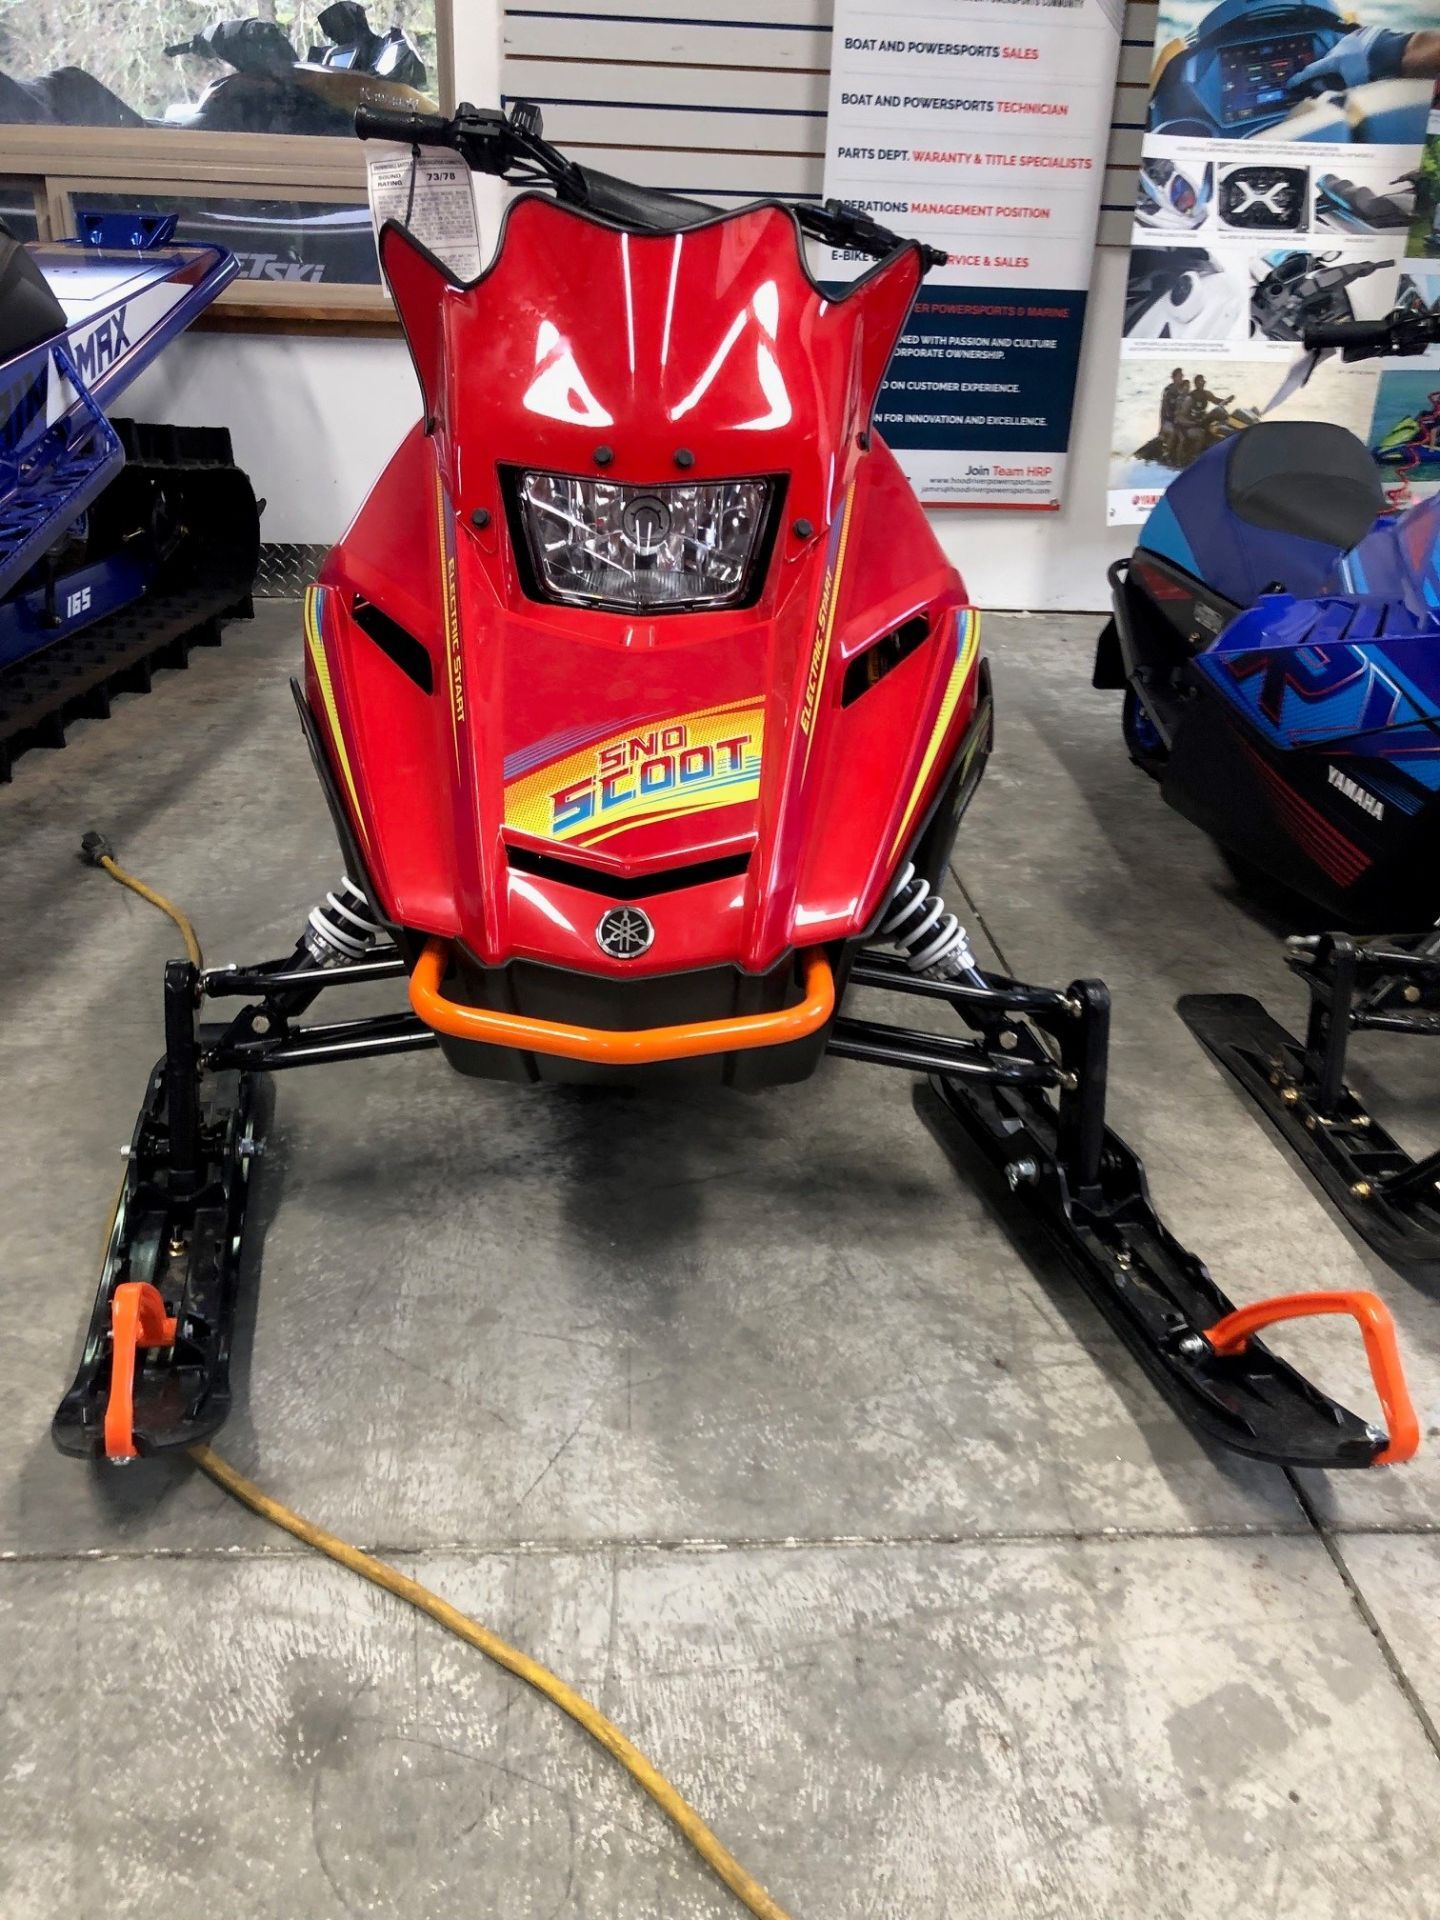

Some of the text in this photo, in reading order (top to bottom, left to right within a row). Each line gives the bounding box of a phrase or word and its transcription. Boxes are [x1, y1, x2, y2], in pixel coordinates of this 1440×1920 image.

[845, 38, 1039, 60] BOAT AND POWERSPORTS SALES
[841, 93, 1068, 115] BOAT AND POWERSPORTS TECHNICIAN
[838, 147, 1092, 169] PARTS DEPT. WARANTY & TITLE SPECIALISTS
[427, 172, 456, 181] 73/78
[842, 200, 1050, 218] PERATIONS MANAGEMENT POSITION
[832, 250, 869, 262] E-BIKE
[948, 255, 1029, 268] RVICE & SALES
[932, 304, 1016, 317] POWERSPORTS
[1027, 307, 1070, 318] MARINE
[75, 305, 131, 380] MAX
[921, 336, 947, 345] WITH
[949, 336, 989, 347] PASSION
[991, 338, 1012, 348] AND
[1013, 338, 1057, 349] CULTURE
[894, 348, 1005, 360] ORPORATE OWNERSHIP.
[890, 381, 905, 390] ON
[907, 382, 959, 392] CUSTOMER
[961, 383, 1021, 393] EXPERIENCE.
[884, 414, 903, 423] FOR
[905, 415, 963, 425] INNOVATION
[965, 416, 986, 425] AND
[987, 416, 1048, 426] EXCELLENCE.
[965, 465, 1052, 476] Join Team HRP
[67, 586, 91, 618] 165
[448, 558, 465, 722] ELECTRIC START
[800, 565, 833, 736] ELECTRIC START
[598, 724, 686, 773] SNO
[548, 735, 752, 834] SCOOT
[1328, 764, 1384, 821] YAMAHA
